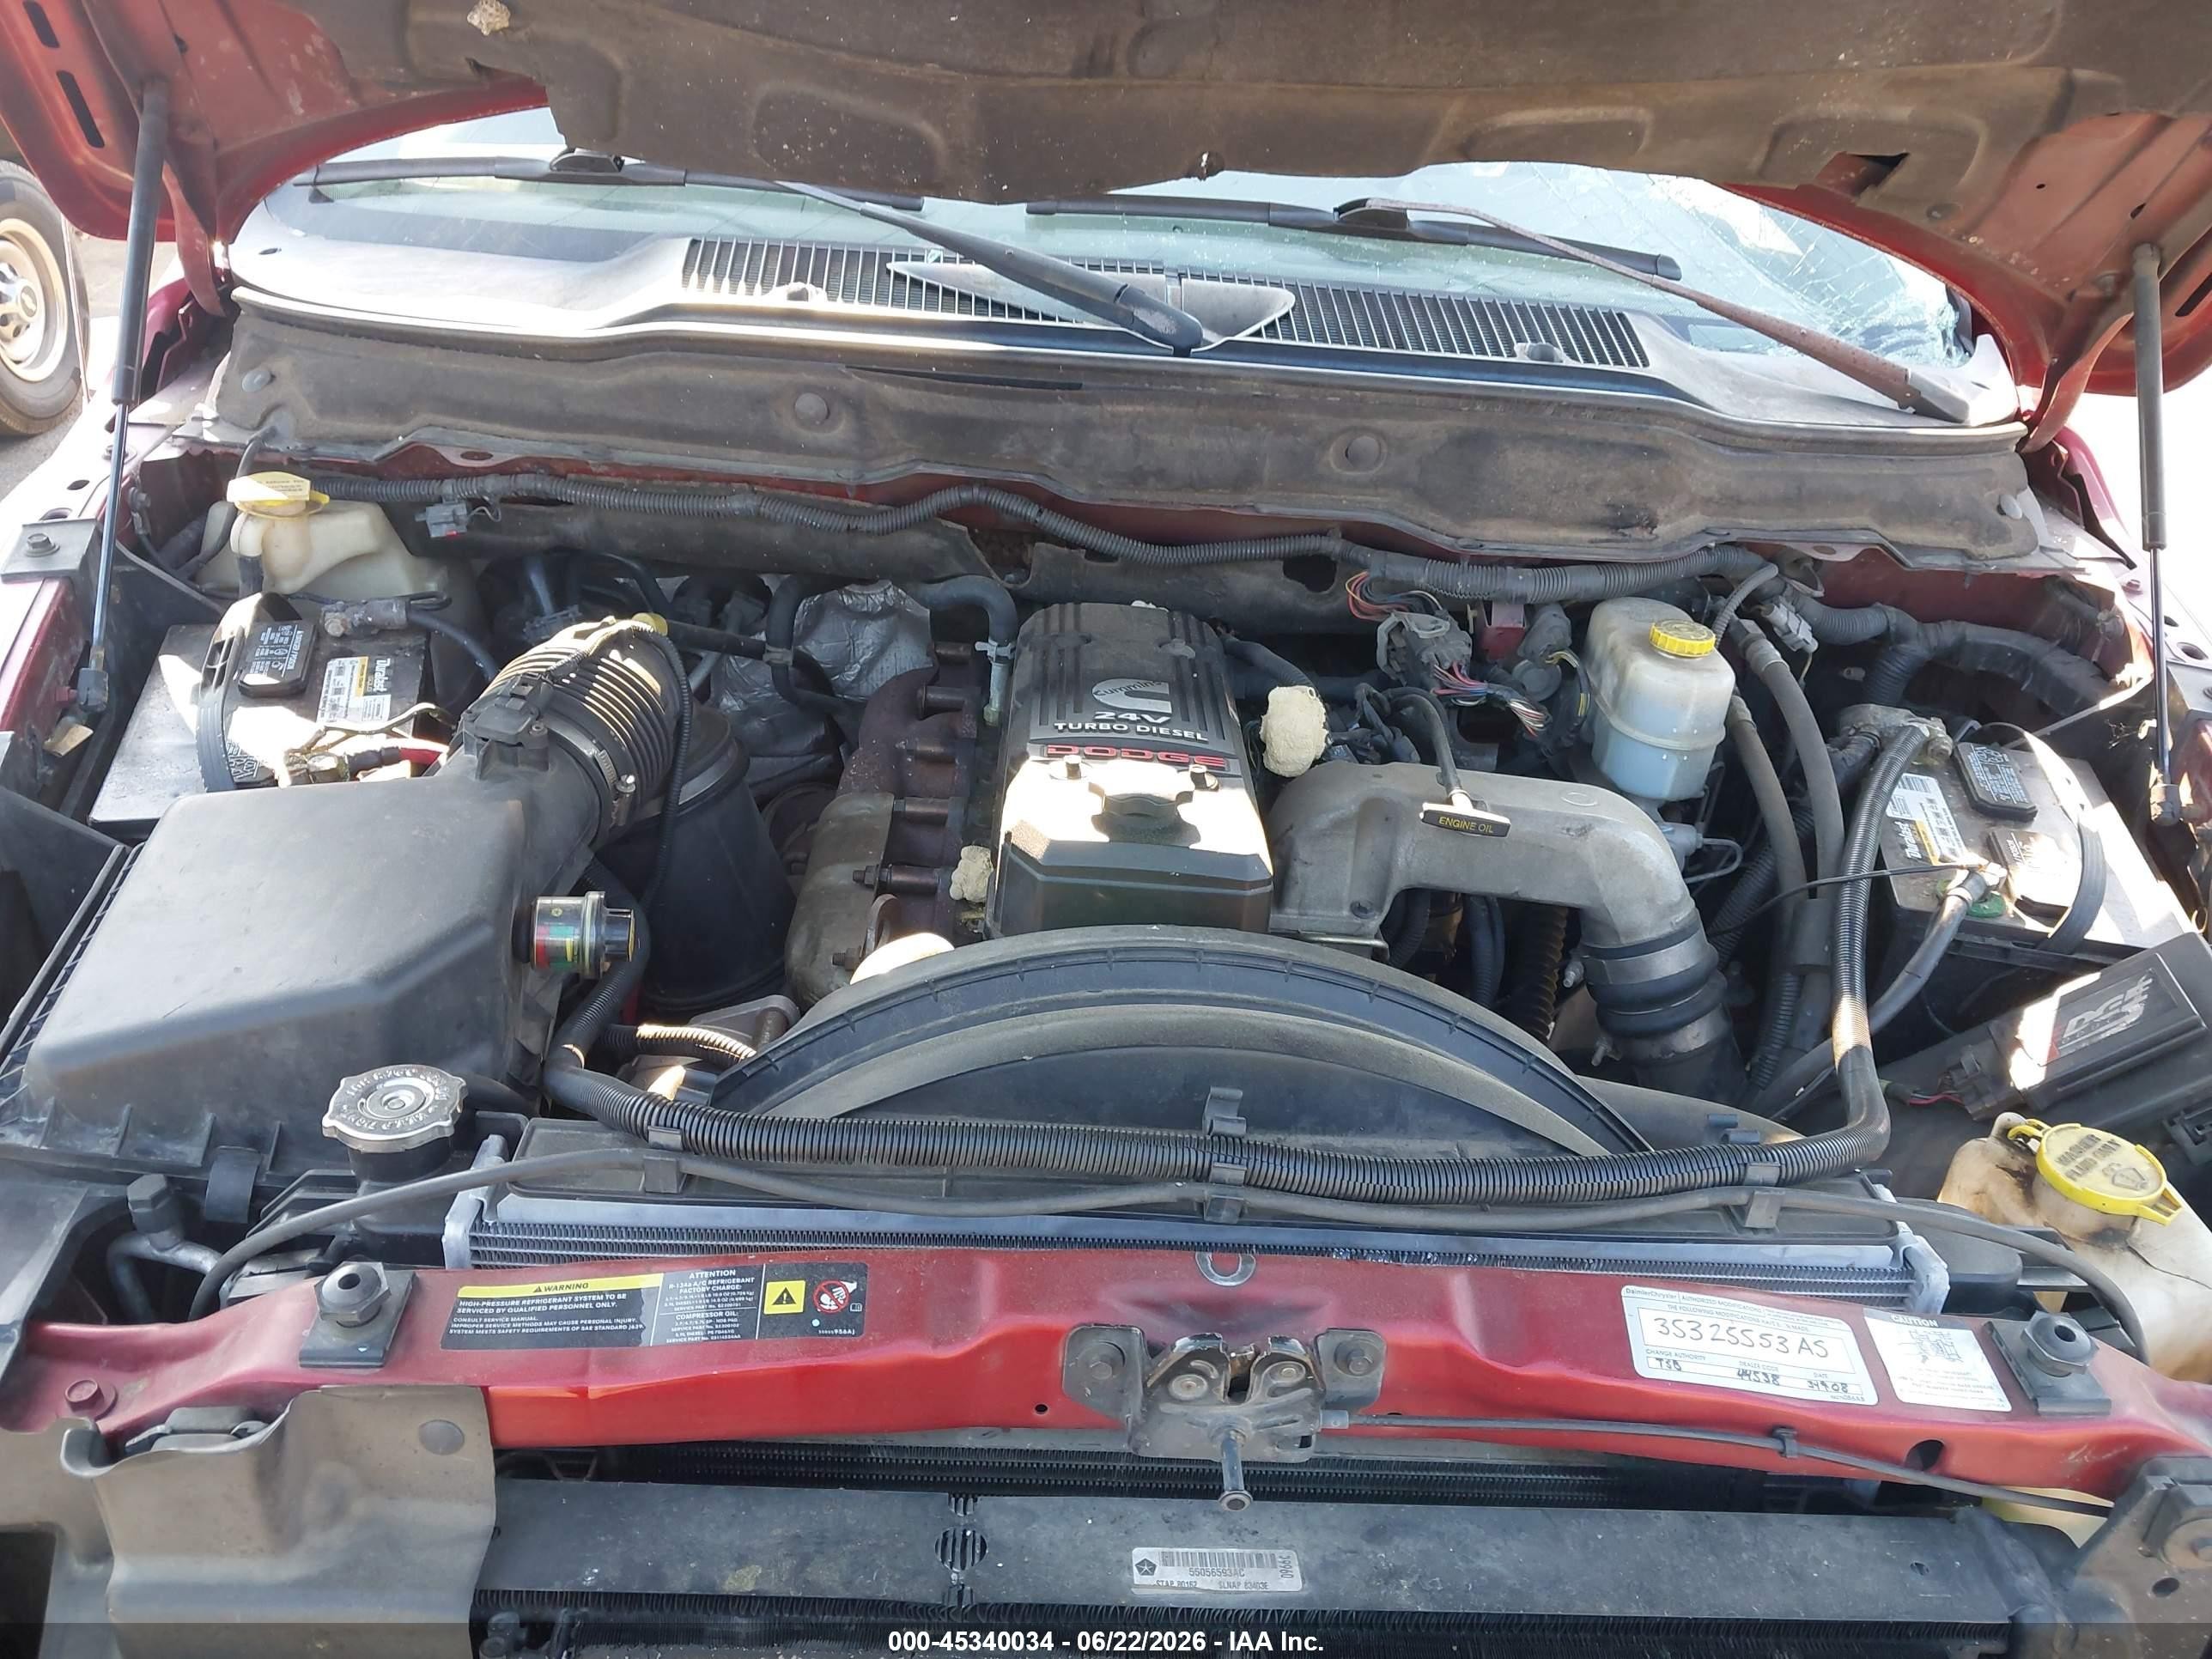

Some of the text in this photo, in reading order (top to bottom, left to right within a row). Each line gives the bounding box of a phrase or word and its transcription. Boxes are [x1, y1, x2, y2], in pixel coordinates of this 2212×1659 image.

[373, 658, 391, 693] Duralast
[1092, 680, 1163, 697] Cummins
[1094, 711, 1171, 724] 24V
[1054, 722, 1209, 741] TURBO DIESEL
[1047, 744, 1225, 767] DODGE
[1438, 817, 1493, 833] ENGINE OIL
[1894, 821, 1923, 859] Duralast
[689, 1269, 736, 1279] ATTENTION
[544, 1283, 589, 1292] WARNING
[708, 1277, 755, 1285] REFRIGERANT
[1626, 1288, 1677, 1299] DaimlerChrysler
[1681, 1295, 1717, 1304] AUTHORIZED
[1717, 1300, 1762, 1313] MODIFICATIONS
[676, 1311, 724, 1321] COMPRESSOR
[1679, 1305, 1714, 1315] FOLLOWING
[1715, 1310, 1759, 1323] MODIFICATIONS
[1891, 1315, 1939, 1328] CAUTION
[1645, 1348, 1706, 1361] CHANGE AUTHORITY
[1739, 1361, 1761, 1370] DEALER
